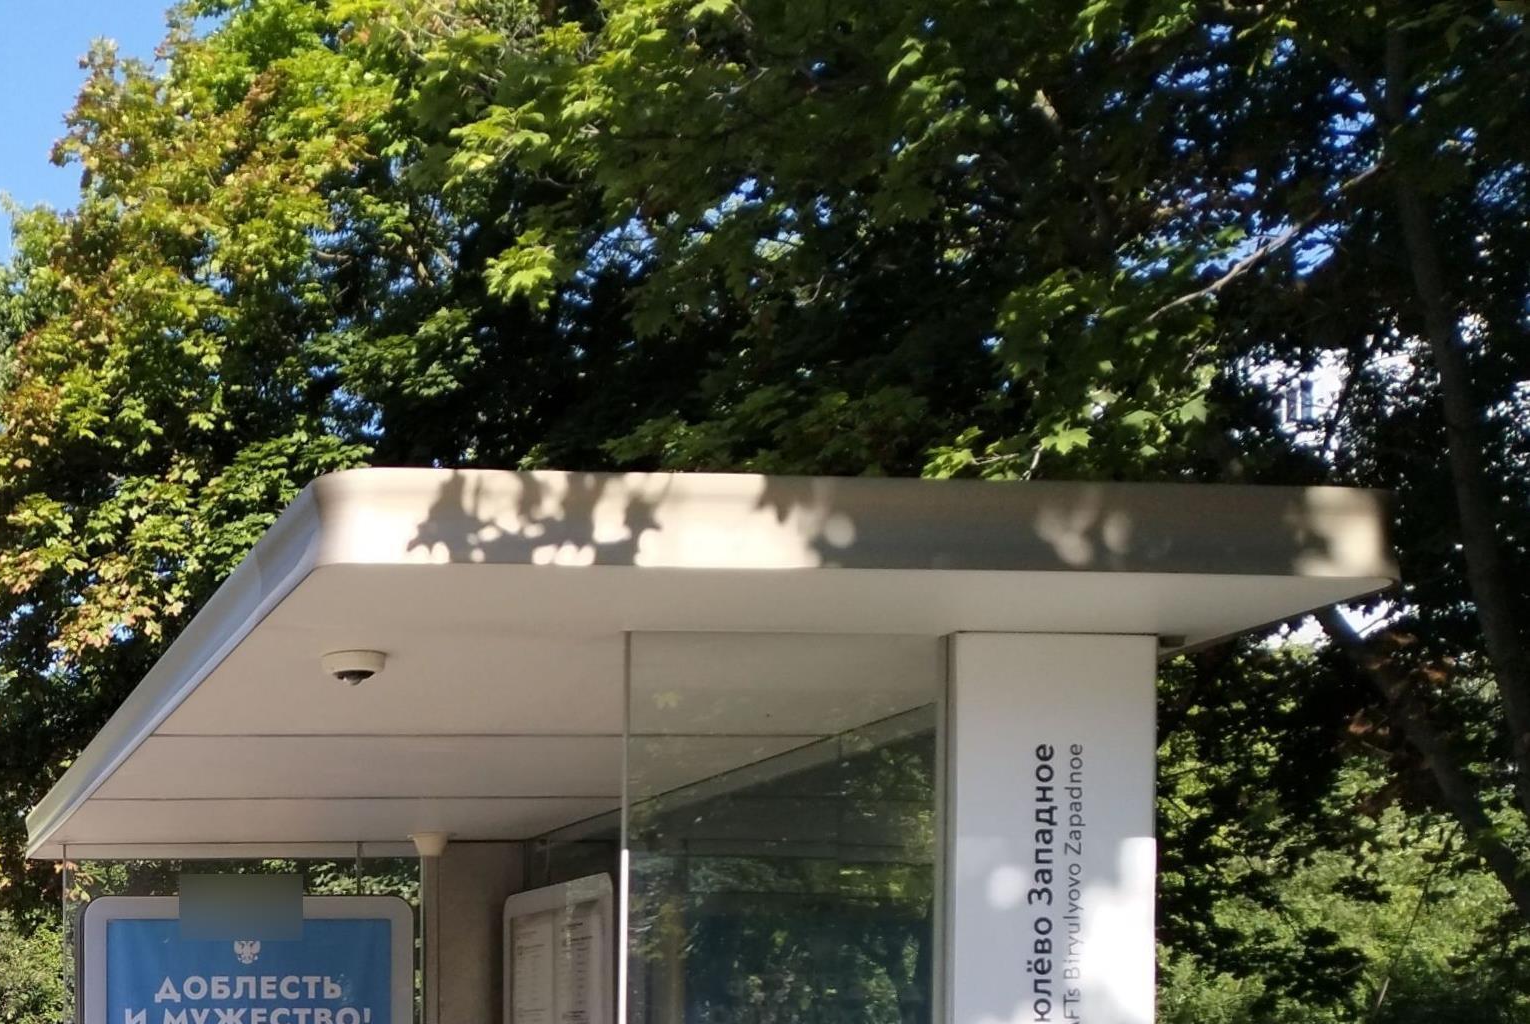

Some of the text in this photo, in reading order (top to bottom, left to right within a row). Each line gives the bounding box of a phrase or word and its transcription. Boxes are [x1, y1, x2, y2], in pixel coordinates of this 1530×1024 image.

[1027, 743, 1058, 906] Западное
[1064, 743, 1086, 855] Zapadnoe
[1063, 863, 1085, 979] Biryulyovo
[154, 975, 343, 1003] ДОБЛЕСТЬ
